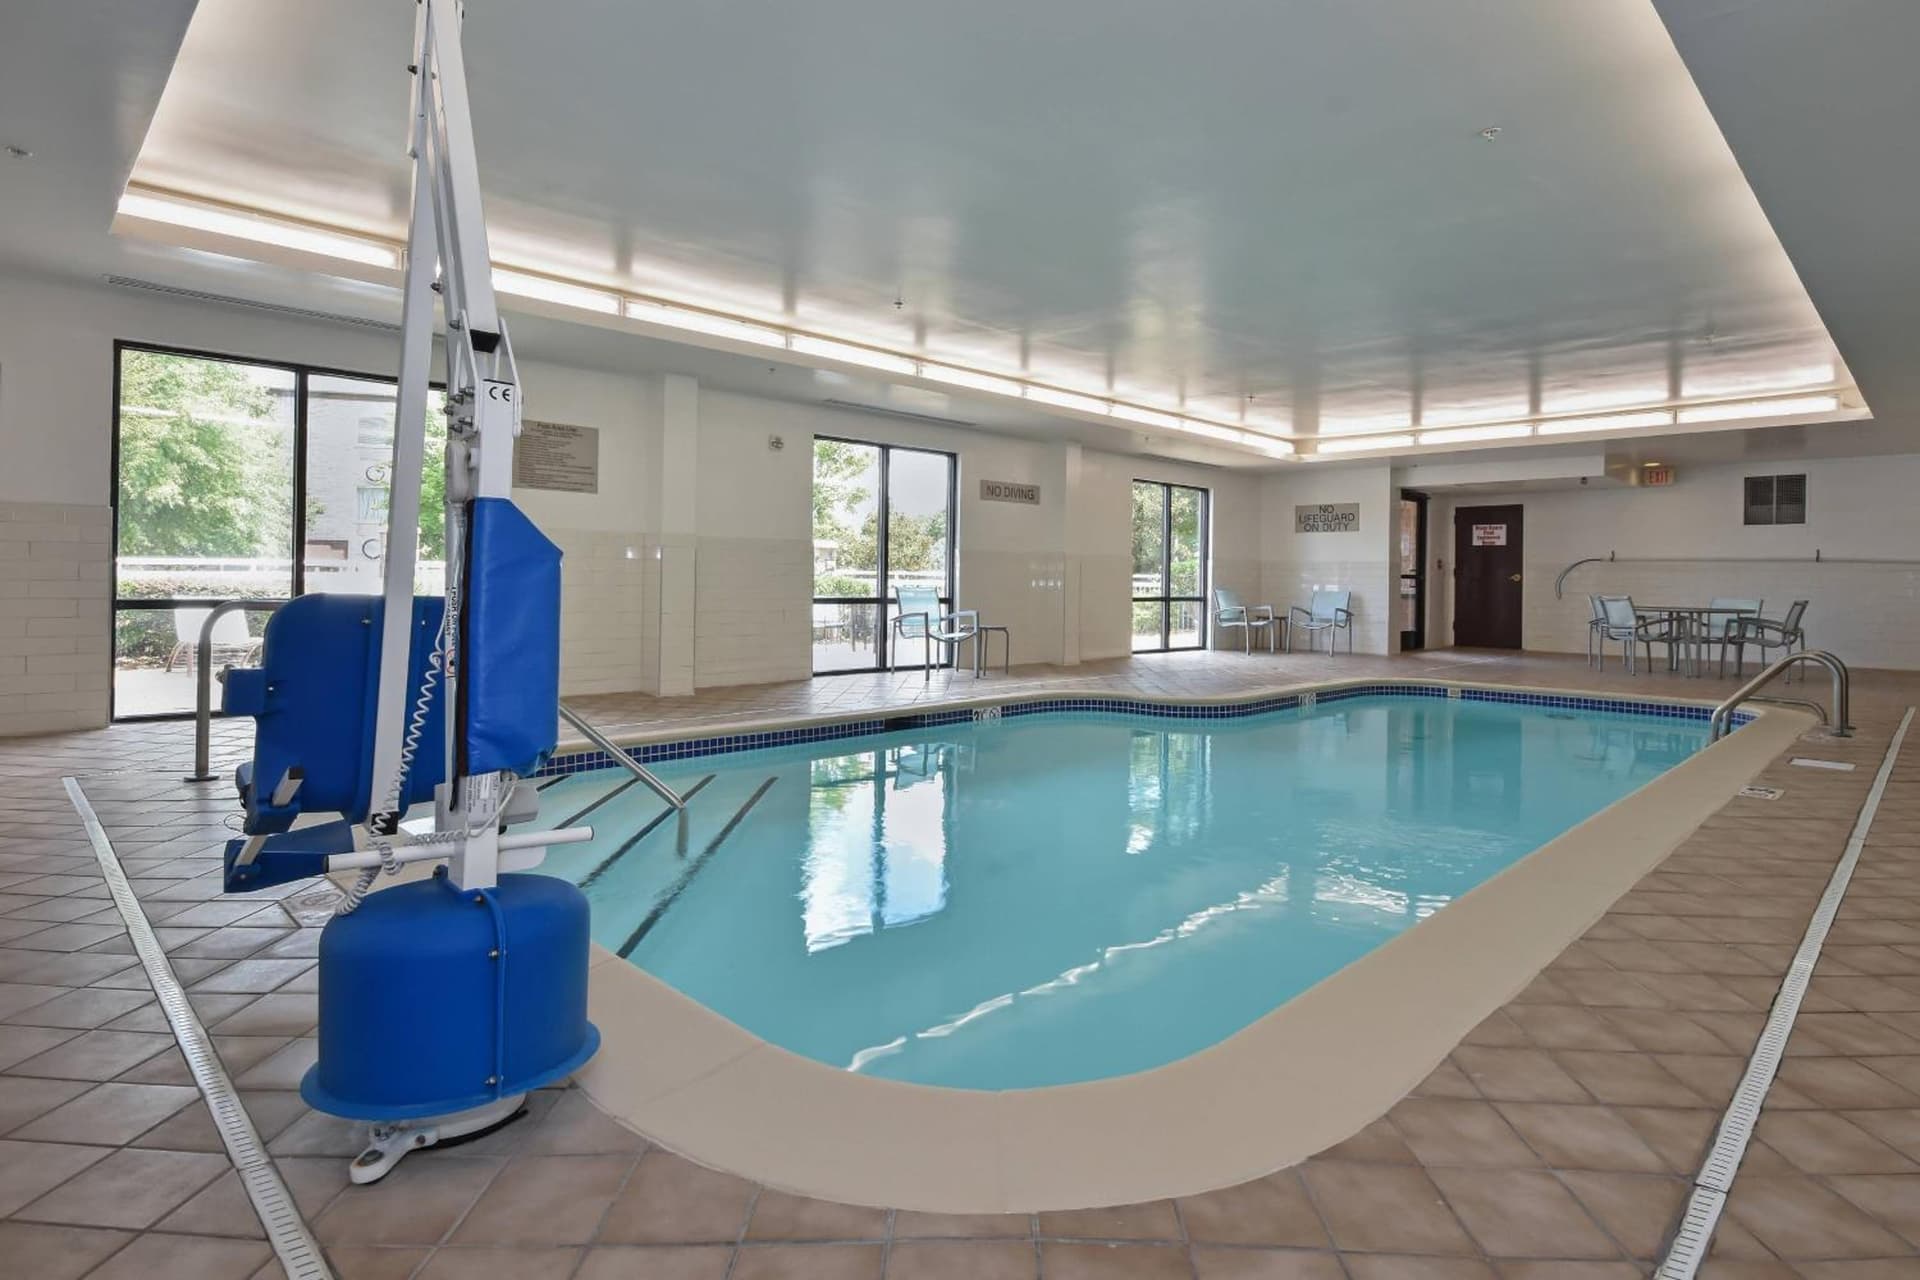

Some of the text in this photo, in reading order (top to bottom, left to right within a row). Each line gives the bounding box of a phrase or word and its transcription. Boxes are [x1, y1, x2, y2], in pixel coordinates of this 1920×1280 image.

[489, 386, 510, 402] CE
[1649, 471, 1669, 484] EXIT
[986, 485, 1034, 500] NO DIVING
[1320, 504, 1335, 514] NO
[1299, 512, 1355, 524] LIFEGUARD
[1304, 522, 1350, 532] ON DUTY
